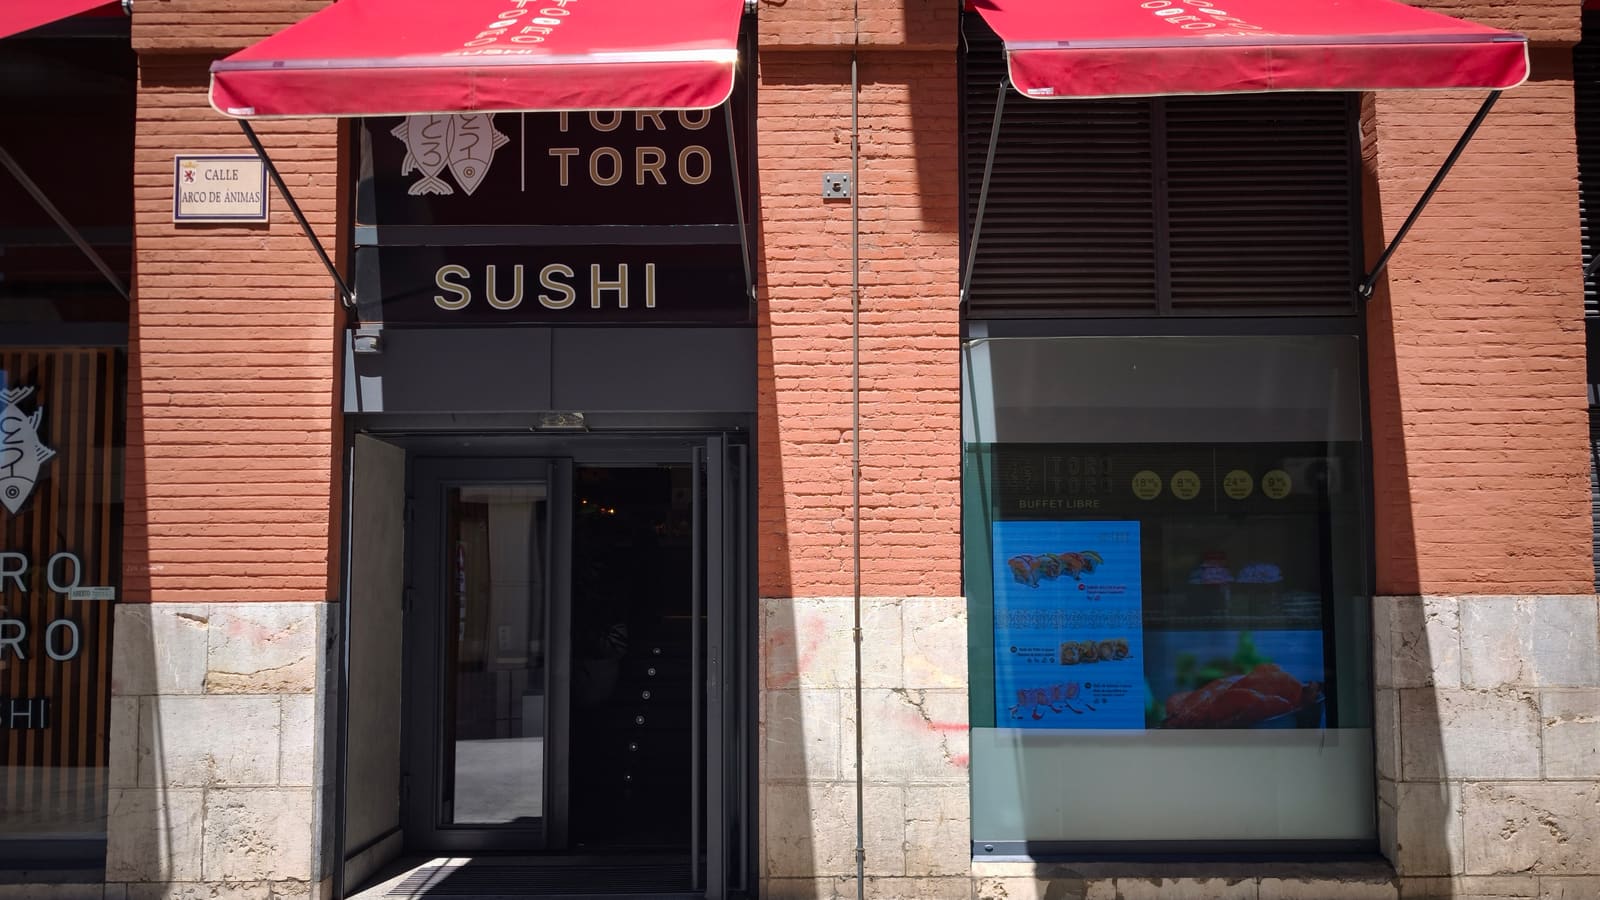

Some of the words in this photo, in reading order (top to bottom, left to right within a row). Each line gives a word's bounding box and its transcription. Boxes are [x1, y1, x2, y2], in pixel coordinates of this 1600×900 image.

[549, 146, 712, 187] TORO
[204, 169, 239, 181] CALLE
[182, 192, 207, 203] ARCO
[209, 192, 221, 203] DE
[224, 187, 260, 203] ÁNIMAS
[434, 263, 656, 311] SUSHI
[1018, 499, 1064, 509] BUFFET
[1066, 499, 1101, 509] LIBRE
